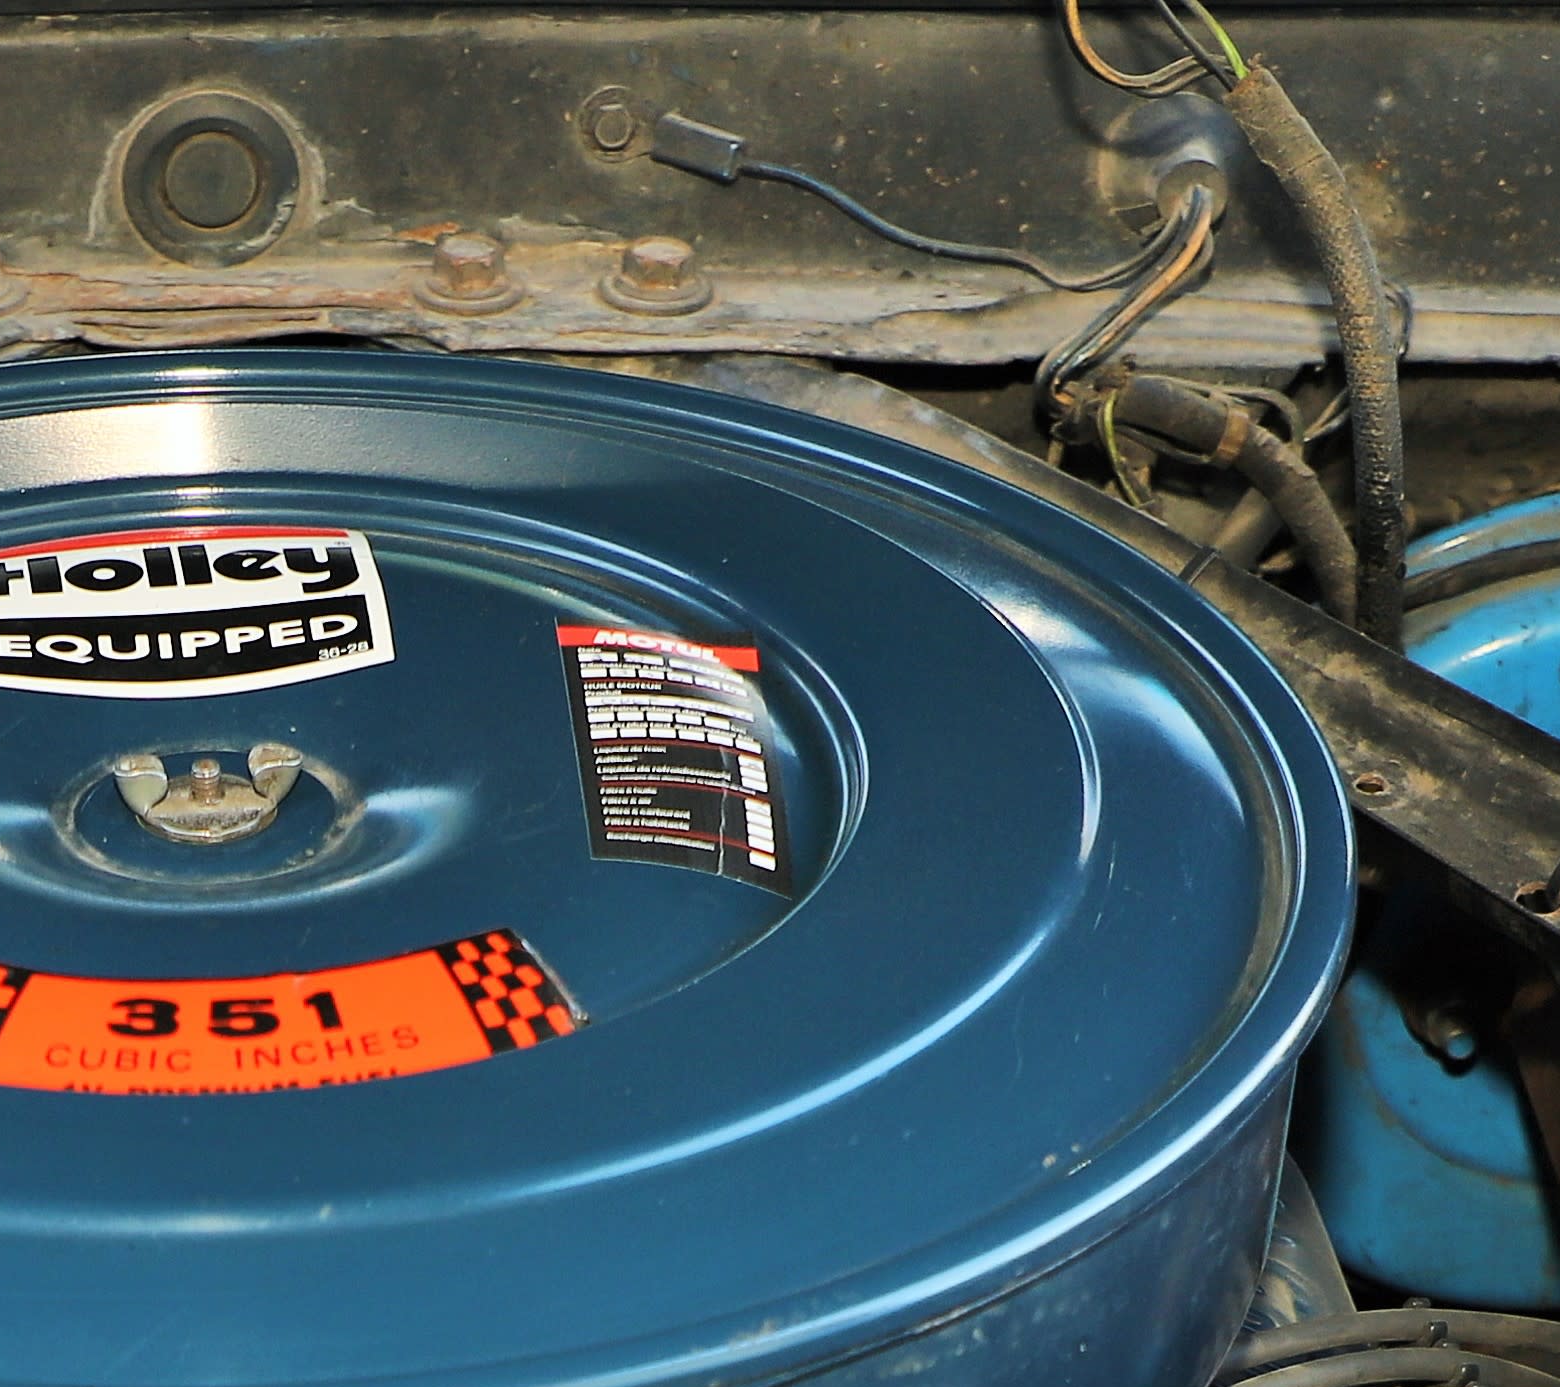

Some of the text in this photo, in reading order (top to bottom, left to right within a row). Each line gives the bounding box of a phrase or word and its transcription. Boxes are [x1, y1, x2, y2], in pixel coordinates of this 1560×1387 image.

[593, 630, 721, 663] MOTUL
[106, 991, 344, 1037] 351
[45, 1026, 420, 1073] CUBIC INCHES
